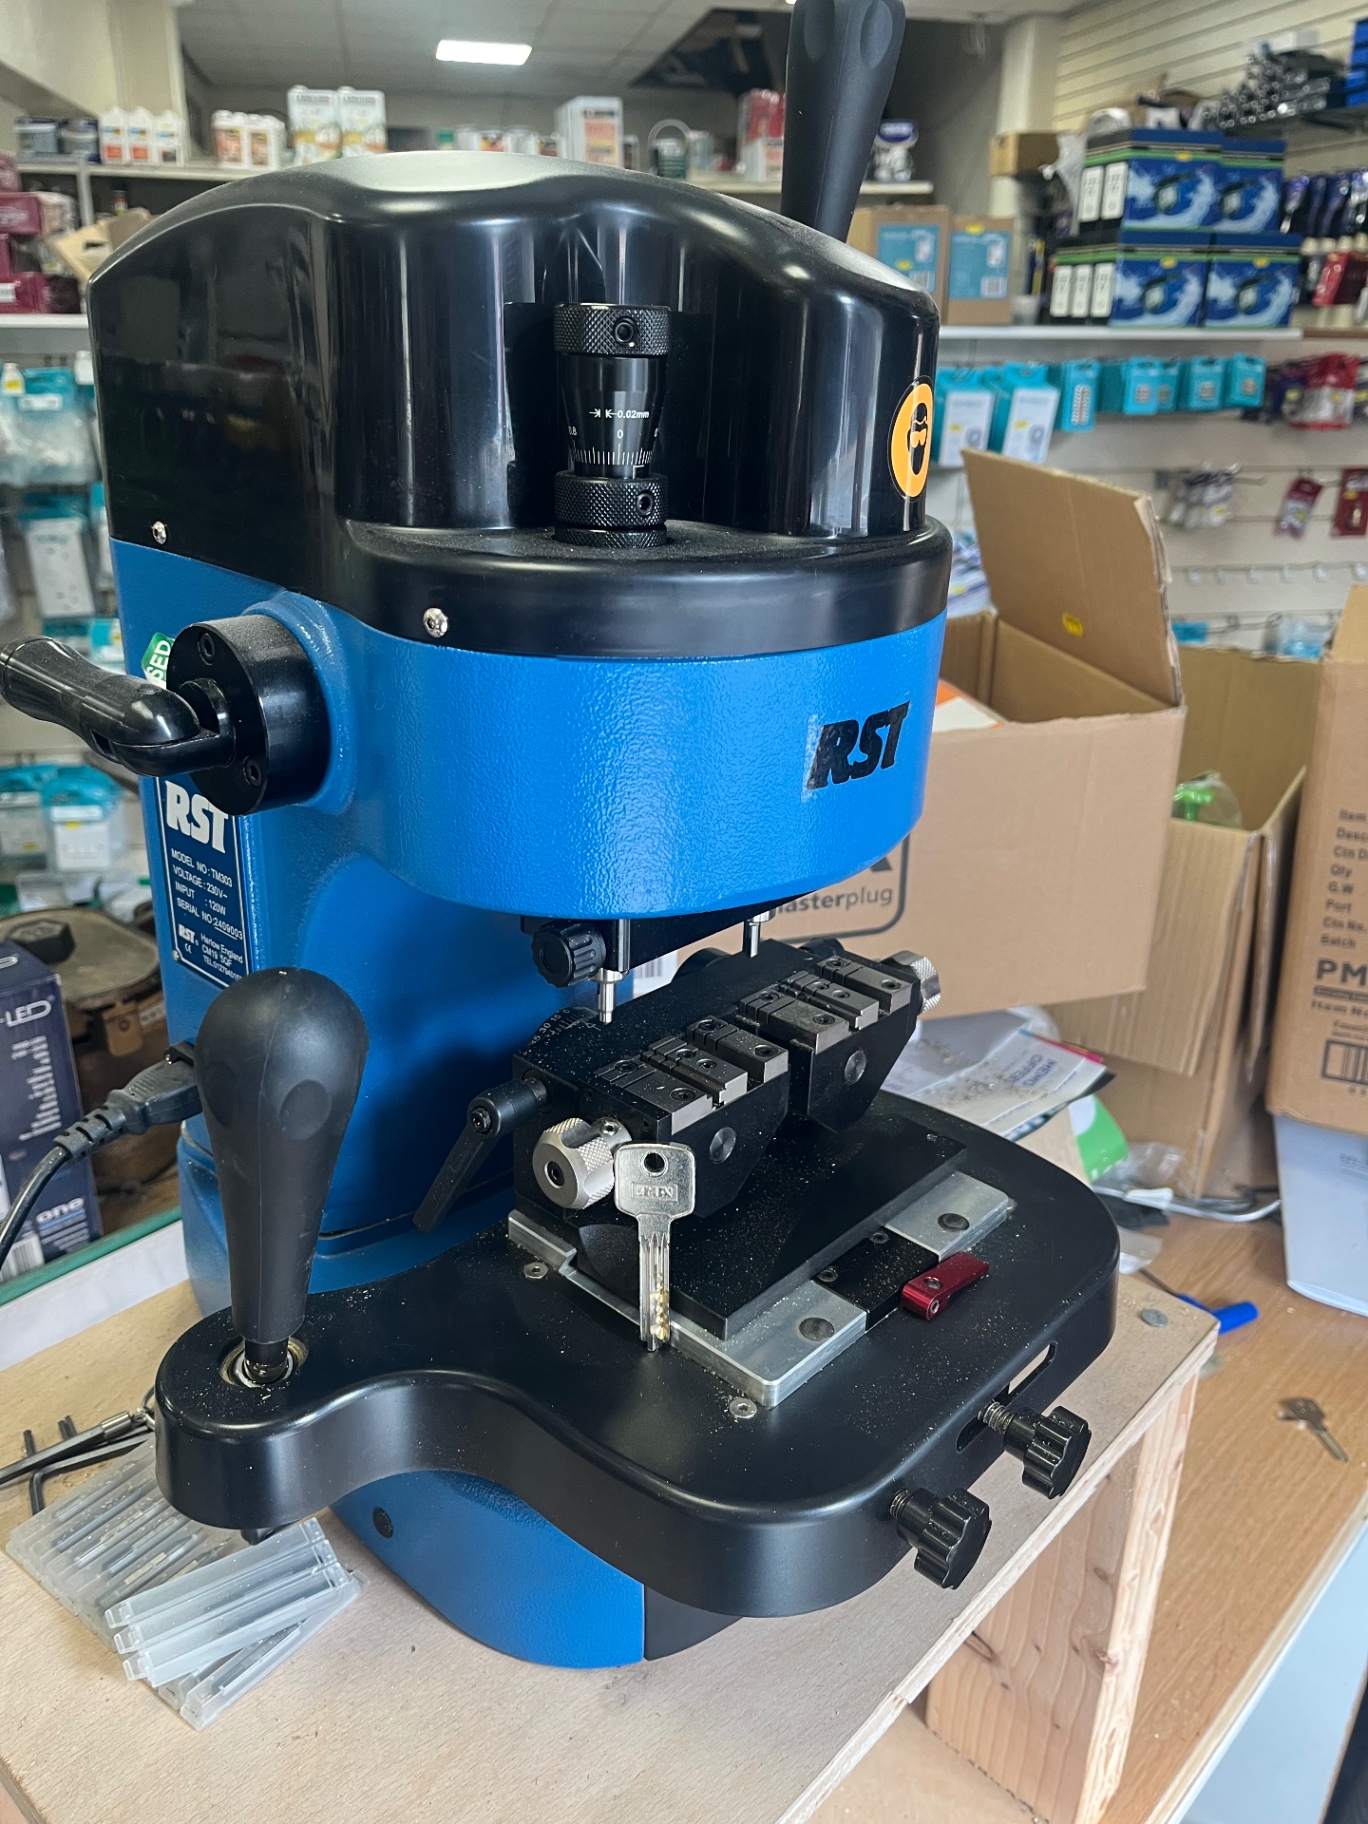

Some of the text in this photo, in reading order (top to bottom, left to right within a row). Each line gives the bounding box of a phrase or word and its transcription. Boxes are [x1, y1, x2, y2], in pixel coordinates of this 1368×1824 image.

[617, 409, 650, 419] 0.02mm
[616, 429, 624, 439] 0
[806, 700, 911, 790] RST
[165, 780, 229, 854] RST
[171, 848, 195, 868] MODEL
[175, 881, 196, 900] INPUT
[776, 886, 893, 914] asterplug
[177, 897, 200, 918] SERIAL
[178, 923, 196, 944] RST
[200, 933, 244, 964] Harlow England
